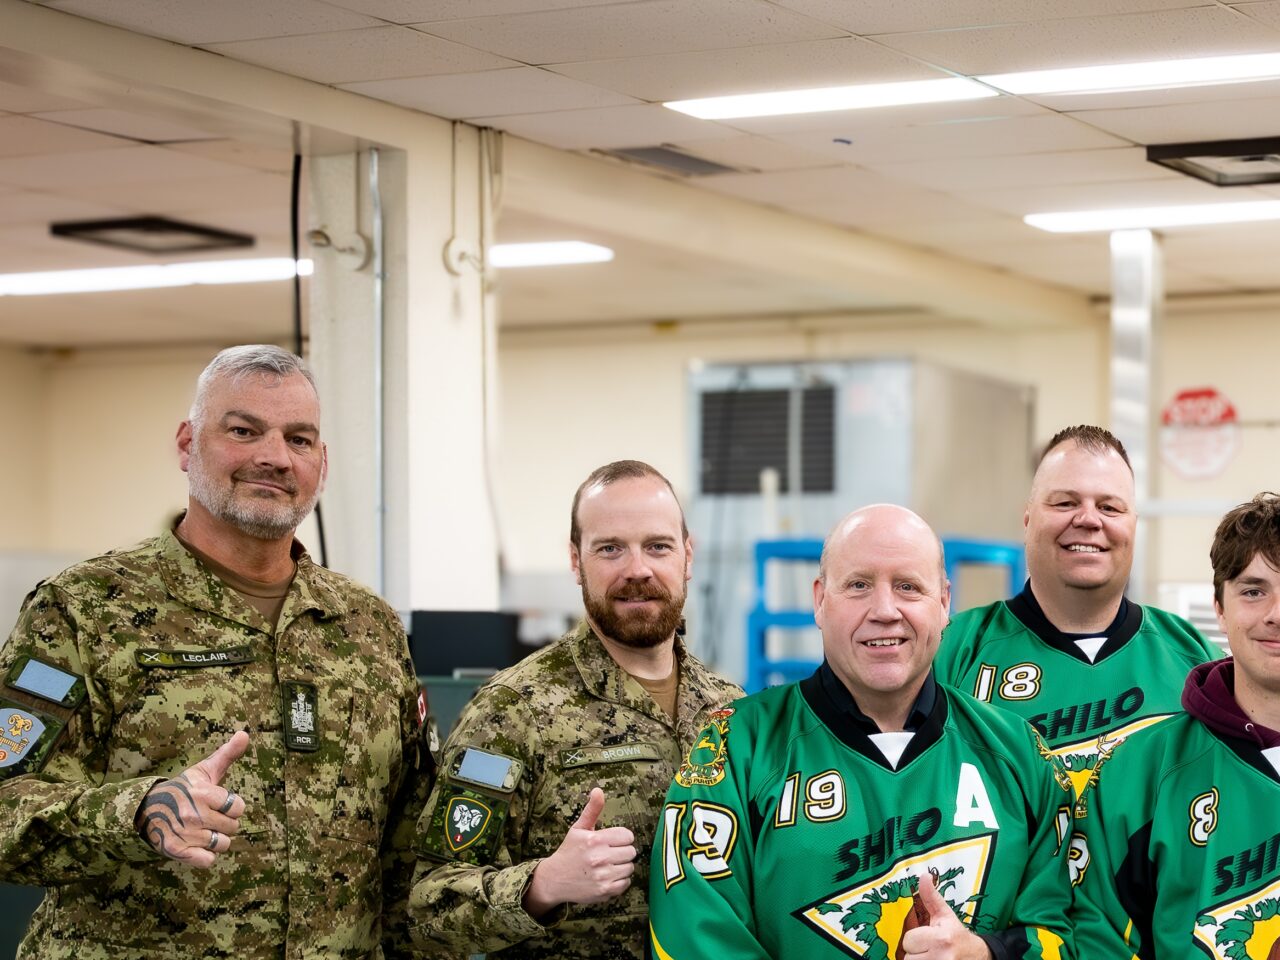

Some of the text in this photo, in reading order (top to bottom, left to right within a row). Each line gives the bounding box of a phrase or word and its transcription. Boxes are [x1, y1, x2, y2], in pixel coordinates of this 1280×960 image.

[182, 653, 228, 662] LECLAIR
[973, 662, 1042, 703] 18
[296, 736, 311, 744] RCR
[1025, 686, 1145, 740] SHILO
[602, 747, 641, 759] BROWN
[773, 767, 847, 829] 19
[953, 762, 1000, 830] A
[663, 799, 739, 893] 19
[832, 807, 943, 884] SHILO
